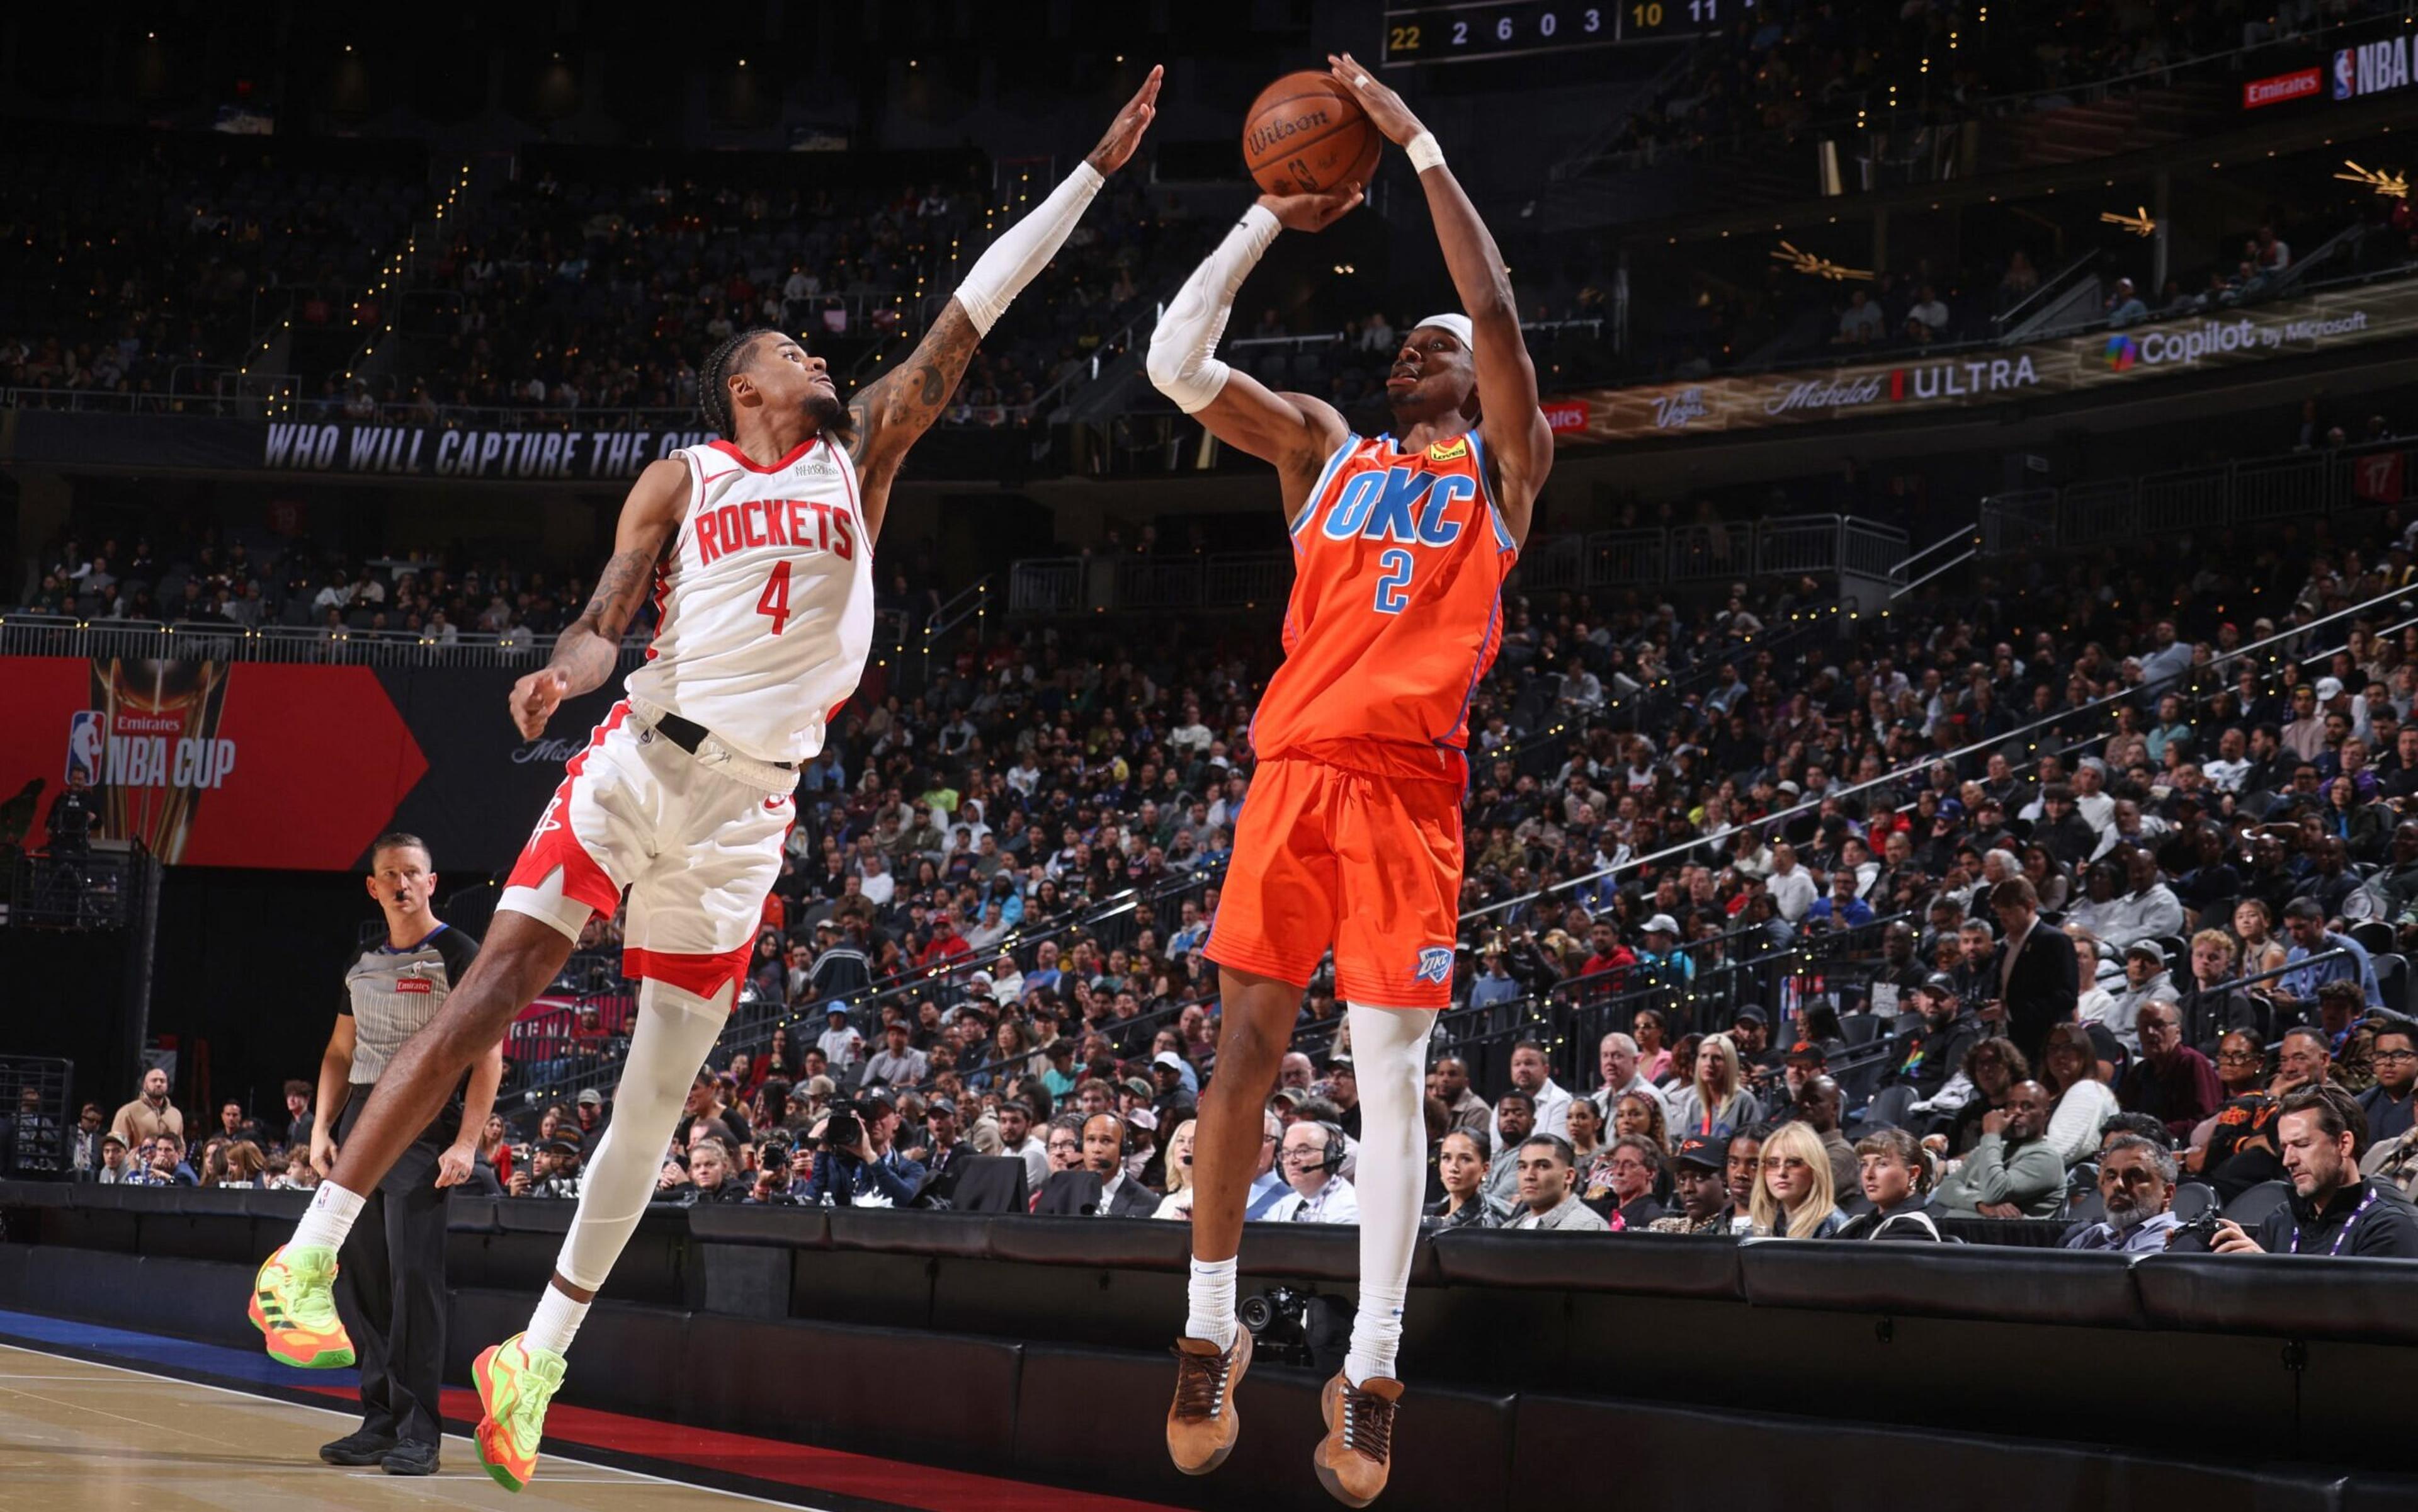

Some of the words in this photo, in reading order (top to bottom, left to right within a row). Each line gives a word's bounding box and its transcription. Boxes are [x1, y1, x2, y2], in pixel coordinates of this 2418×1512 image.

[1390, 26, 1420, 50] 22
[1452, 22, 1468, 44] 2
[1497, 18, 1513, 40] 6
[1540, 13, 1556, 36] 0
[1584, 9, 1600, 31] 3
[1633, 3, 1662, 26] 10
[1688, 0, 1717, 21] 11
[2248, 74, 2316, 103] Emirates
[2357, 37, 2409, 95] NBA
[1249, 111, 1330, 155] Wilson
[2142, 319, 2255, 363] Copilot
[2286, 311, 2368, 341] Microsoft
[1764, 374, 1885, 416] Michelob
[1914, 355, 2039, 398] ULTRA
[1545, 409, 1583, 428] ates
[264, 423, 339, 469] WHO
[348, 427, 424, 473] WILL
[435, 430, 581, 477] CAPTURE
[589, 433, 649, 477] THE
[2364, 462, 2394, 496] 17
[1322, 465, 1476, 547] OKC
[695, 499, 853, 566] ROCKETS
[756, 560, 792, 635] 4
[1373, 548, 1414, 615] 2
[117, 716, 180, 731] Emirates
[106, 736, 167, 787] NBA
[173, 737, 236, 788] CUP
